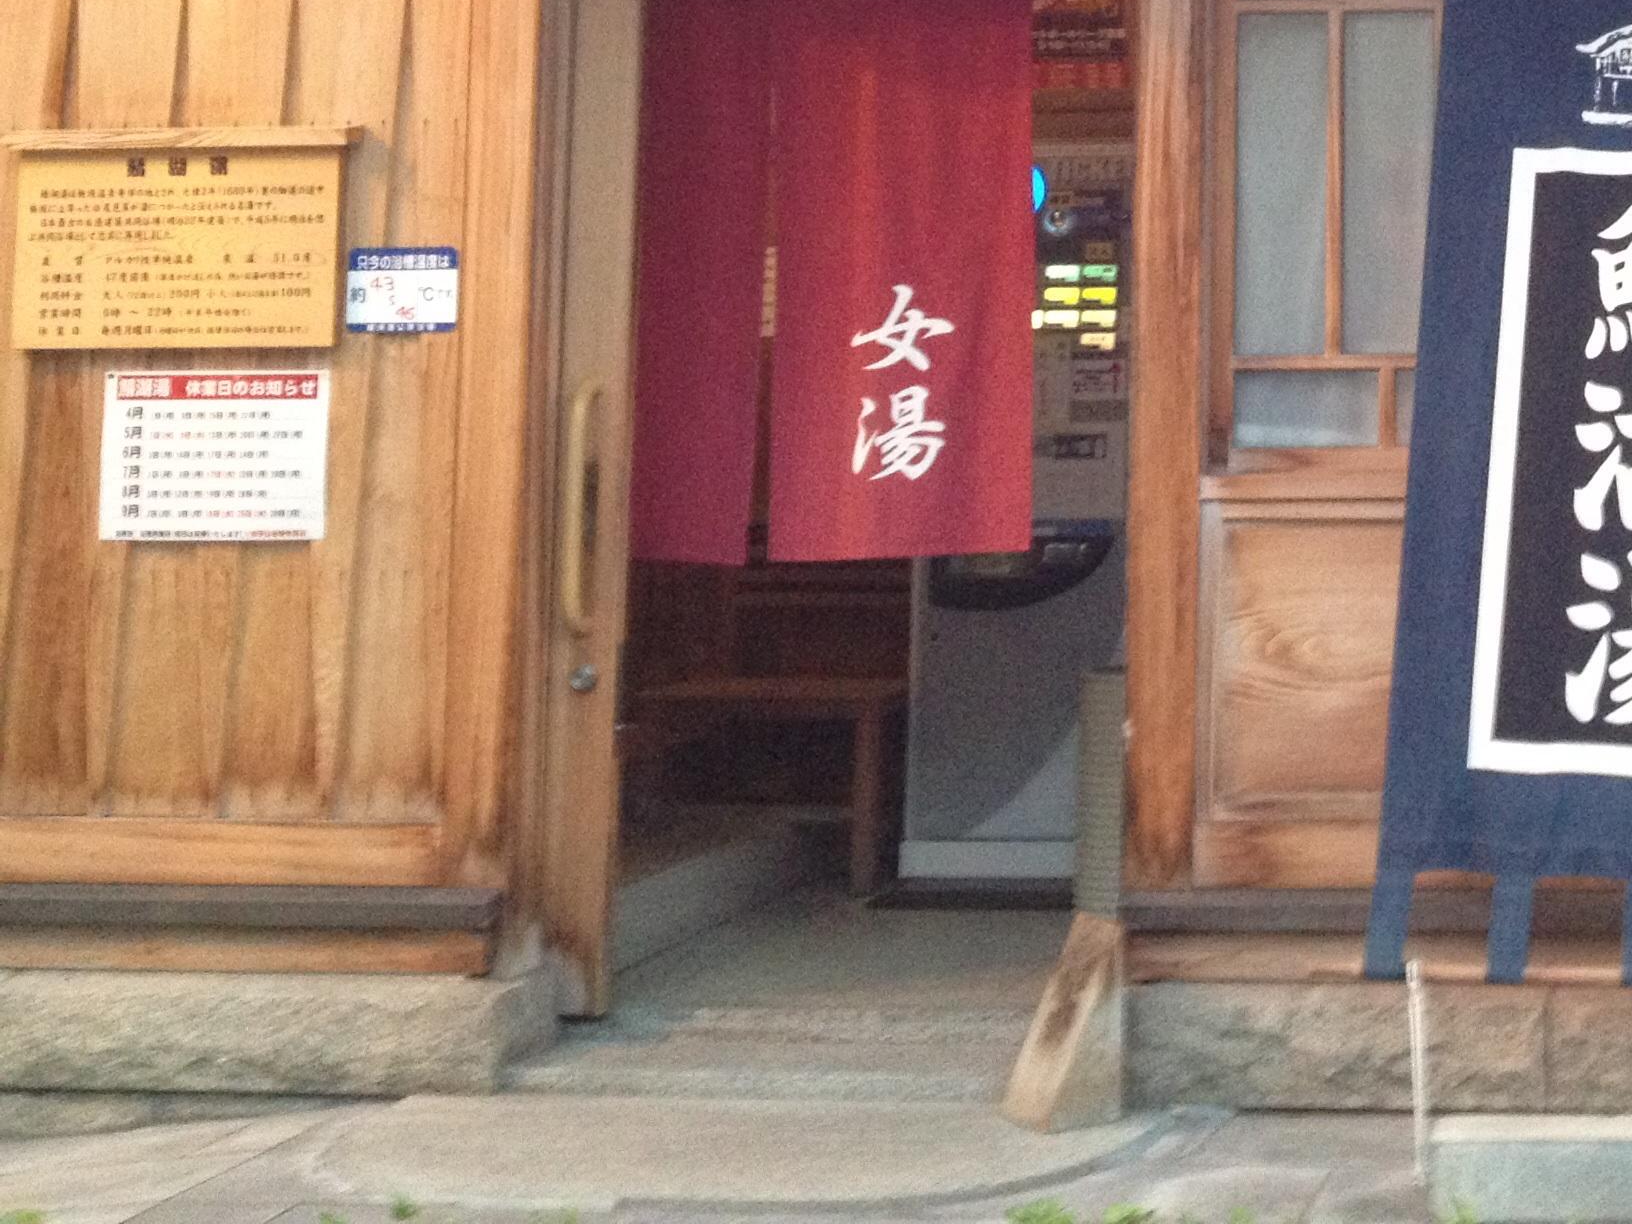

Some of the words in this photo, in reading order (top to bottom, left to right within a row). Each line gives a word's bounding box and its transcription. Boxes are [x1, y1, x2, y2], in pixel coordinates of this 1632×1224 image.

[185, 379, 317, 396] 休業日のお知らせ
[851, 284, 955, 480] 女湯
